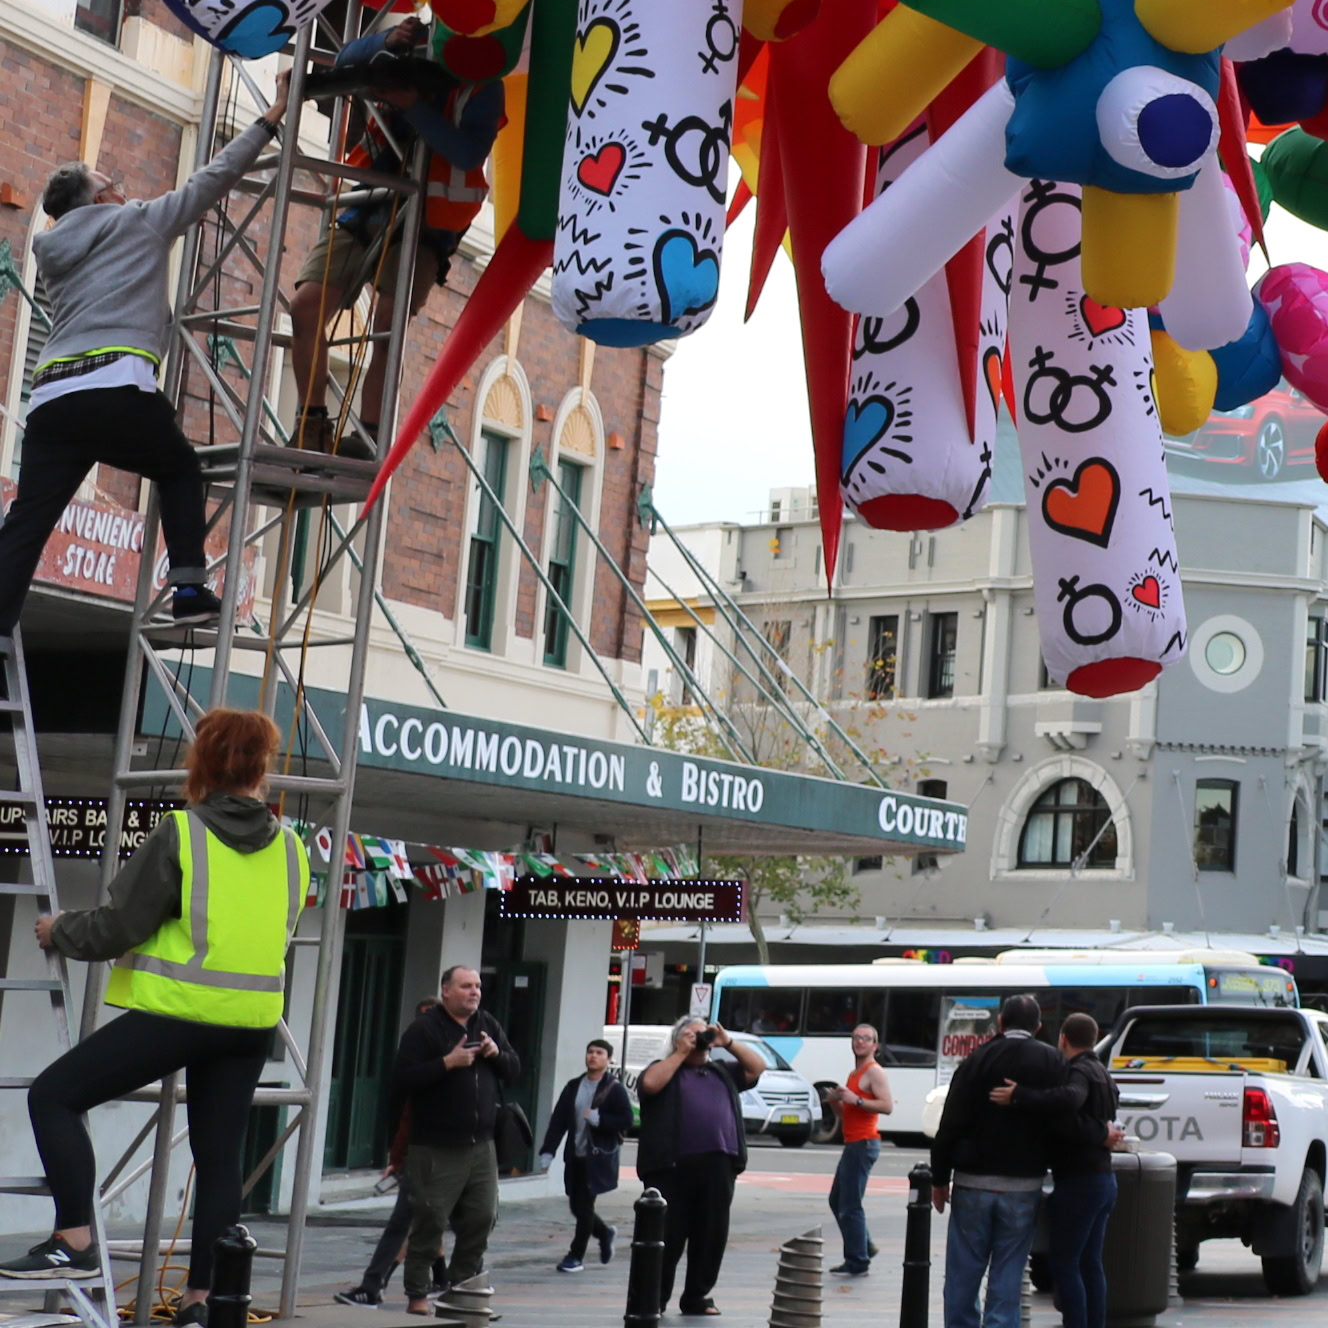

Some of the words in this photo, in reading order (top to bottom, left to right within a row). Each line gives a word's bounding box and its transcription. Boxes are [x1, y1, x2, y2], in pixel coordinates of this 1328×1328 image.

[55, 504, 145, 552] NVENIENC
[63, 543, 116, 586] STORE
[357, 703, 625, 793] ACCOMMODATION
[646, 760, 663, 798] &
[681, 761, 764, 813] BISTRO
[1, 806, 78, 826] UPAIRS
[85, 808, 108, 827] BA
[128, 810, 140, 828] &
[50, 829, 83, 846] V.I.P
[89, 830, 149, 849] LONG
[528, 889, 561, 908] TAB,
[565, 890, 612, 910] KENO,
[616, 891, 650, 909] V.I.P
[655, 892, 714, 910] LOUNGE
[1124, 1116, 1205, 1142] OTA
